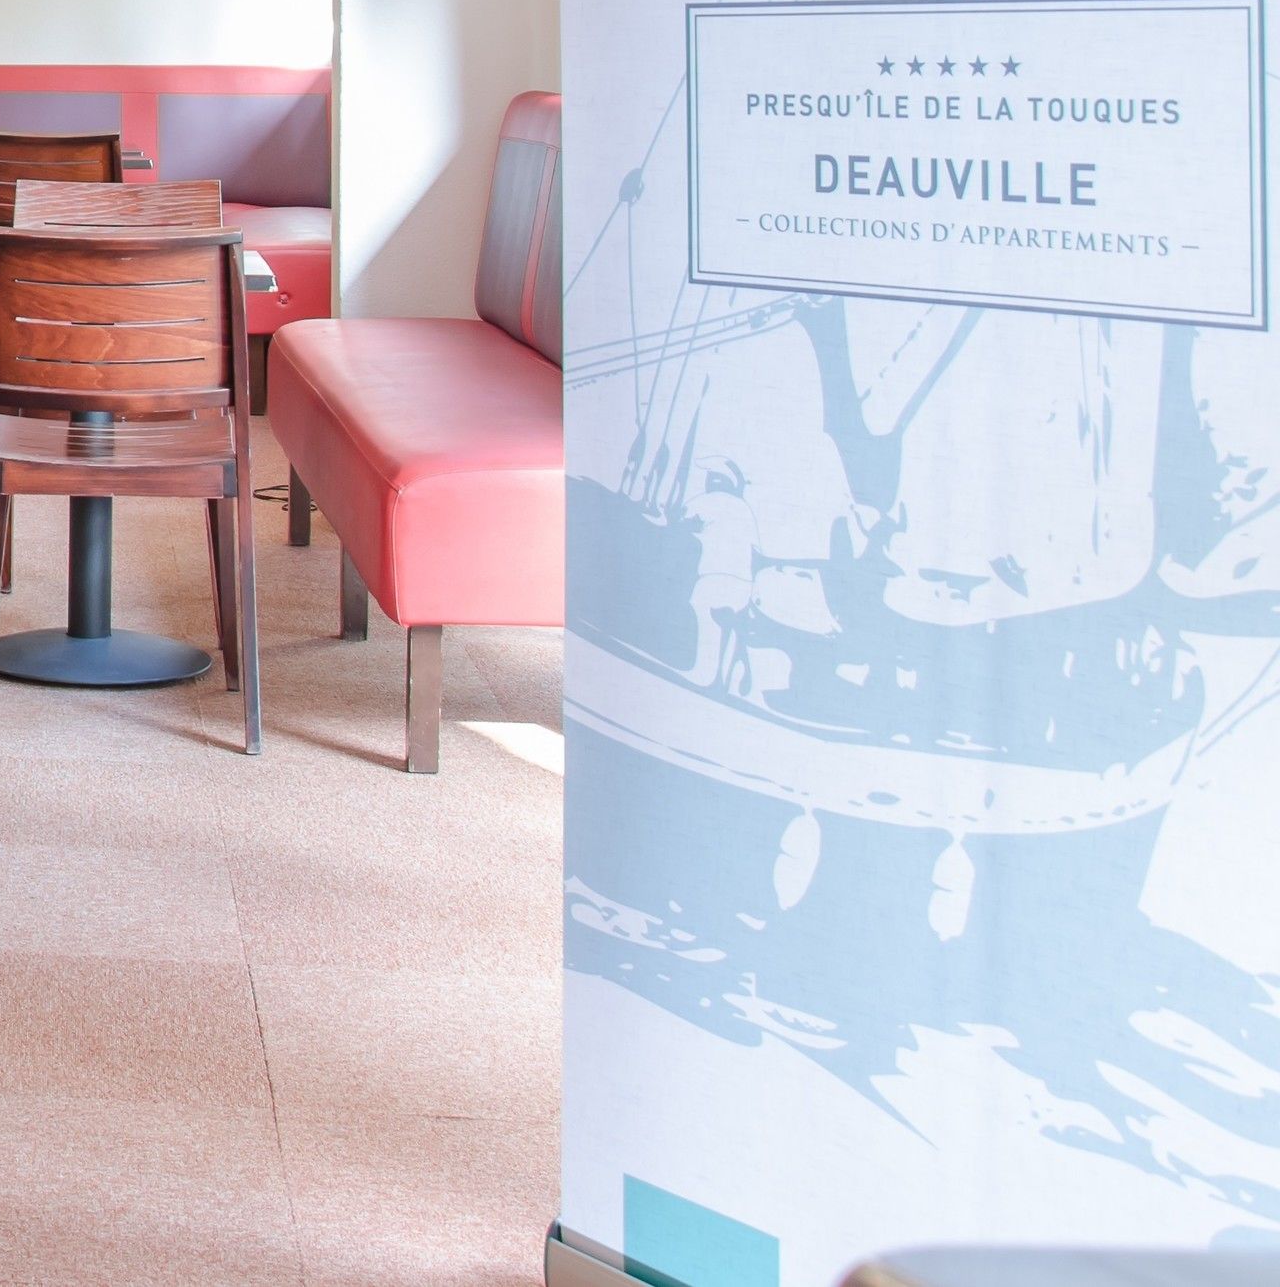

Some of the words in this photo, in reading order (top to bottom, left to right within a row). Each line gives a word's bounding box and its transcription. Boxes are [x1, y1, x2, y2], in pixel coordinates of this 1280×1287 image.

[746, 88, 909, 120] PRESQU'ÎLE
[924, 95, 960, 120] DE
[976, 96, 1013, 122] LA
[1027, 97, 1181, 125] TOUQUES
[814, 153, 1096, 207] DEAUVILLE
[758, 213, 920, 243] COLLECTIONS
[931, 223, 1170, 257] D'APPARTEMENTS
